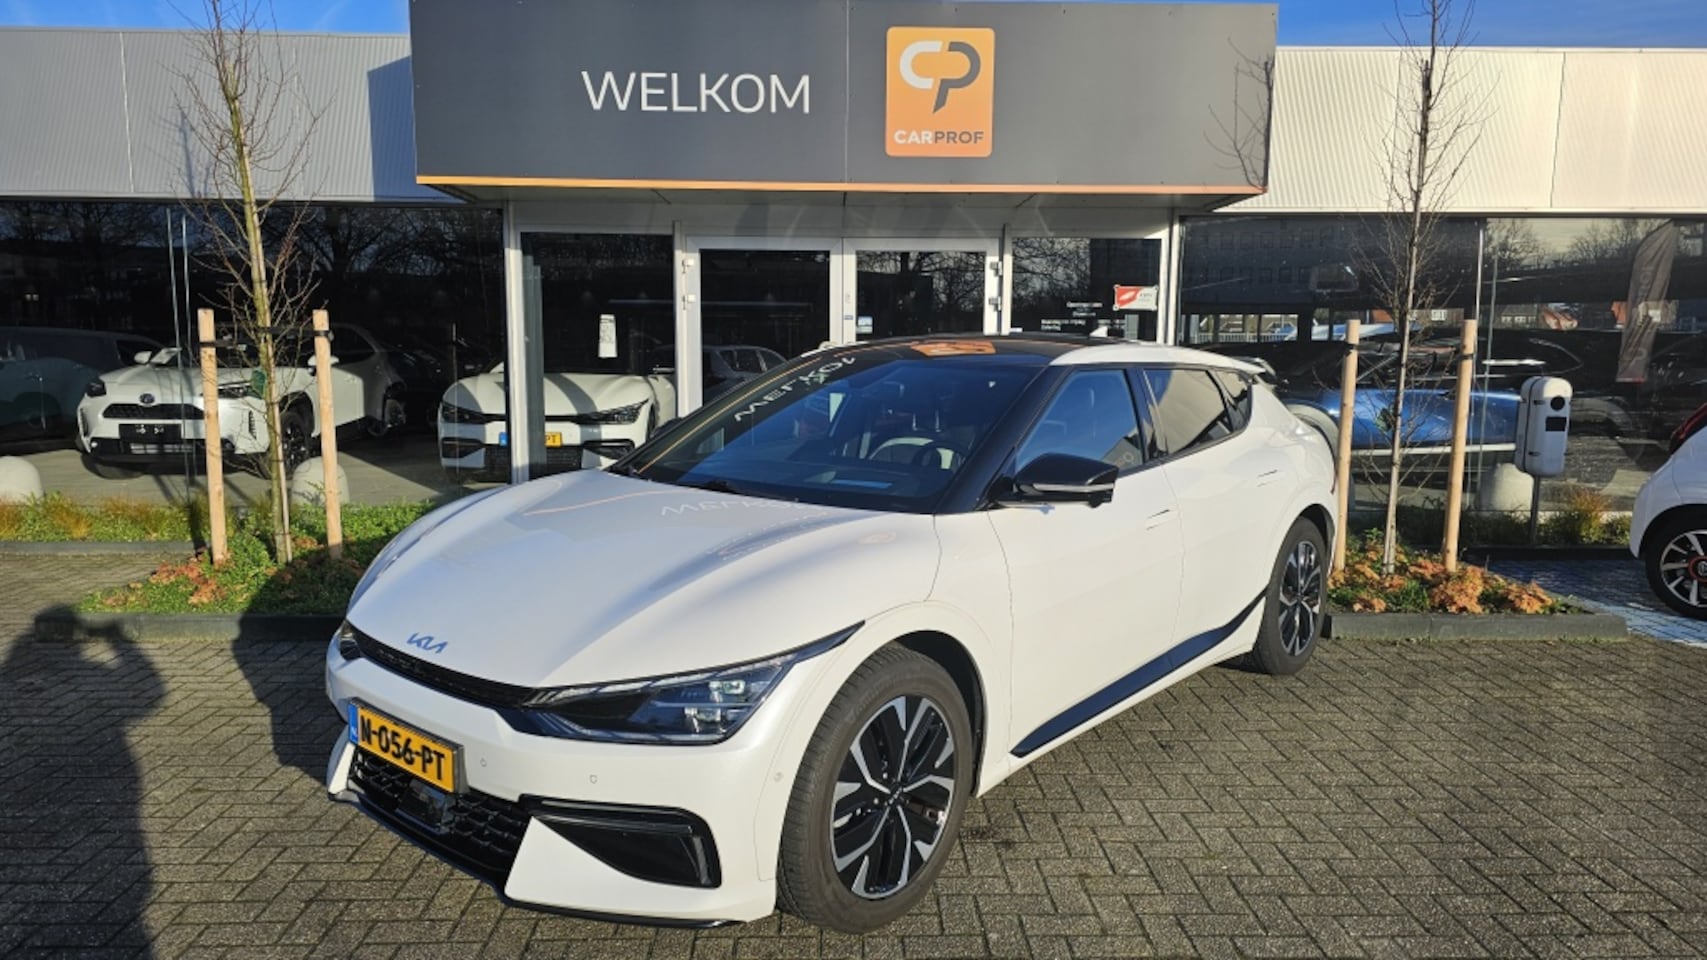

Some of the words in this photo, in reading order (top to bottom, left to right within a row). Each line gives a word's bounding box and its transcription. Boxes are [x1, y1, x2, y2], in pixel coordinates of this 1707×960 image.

[581, 70, 810, 115] WELKOM
[893, 129, 985, 145] CARPROF
[359, 714, 446, 781] N-056-PT
